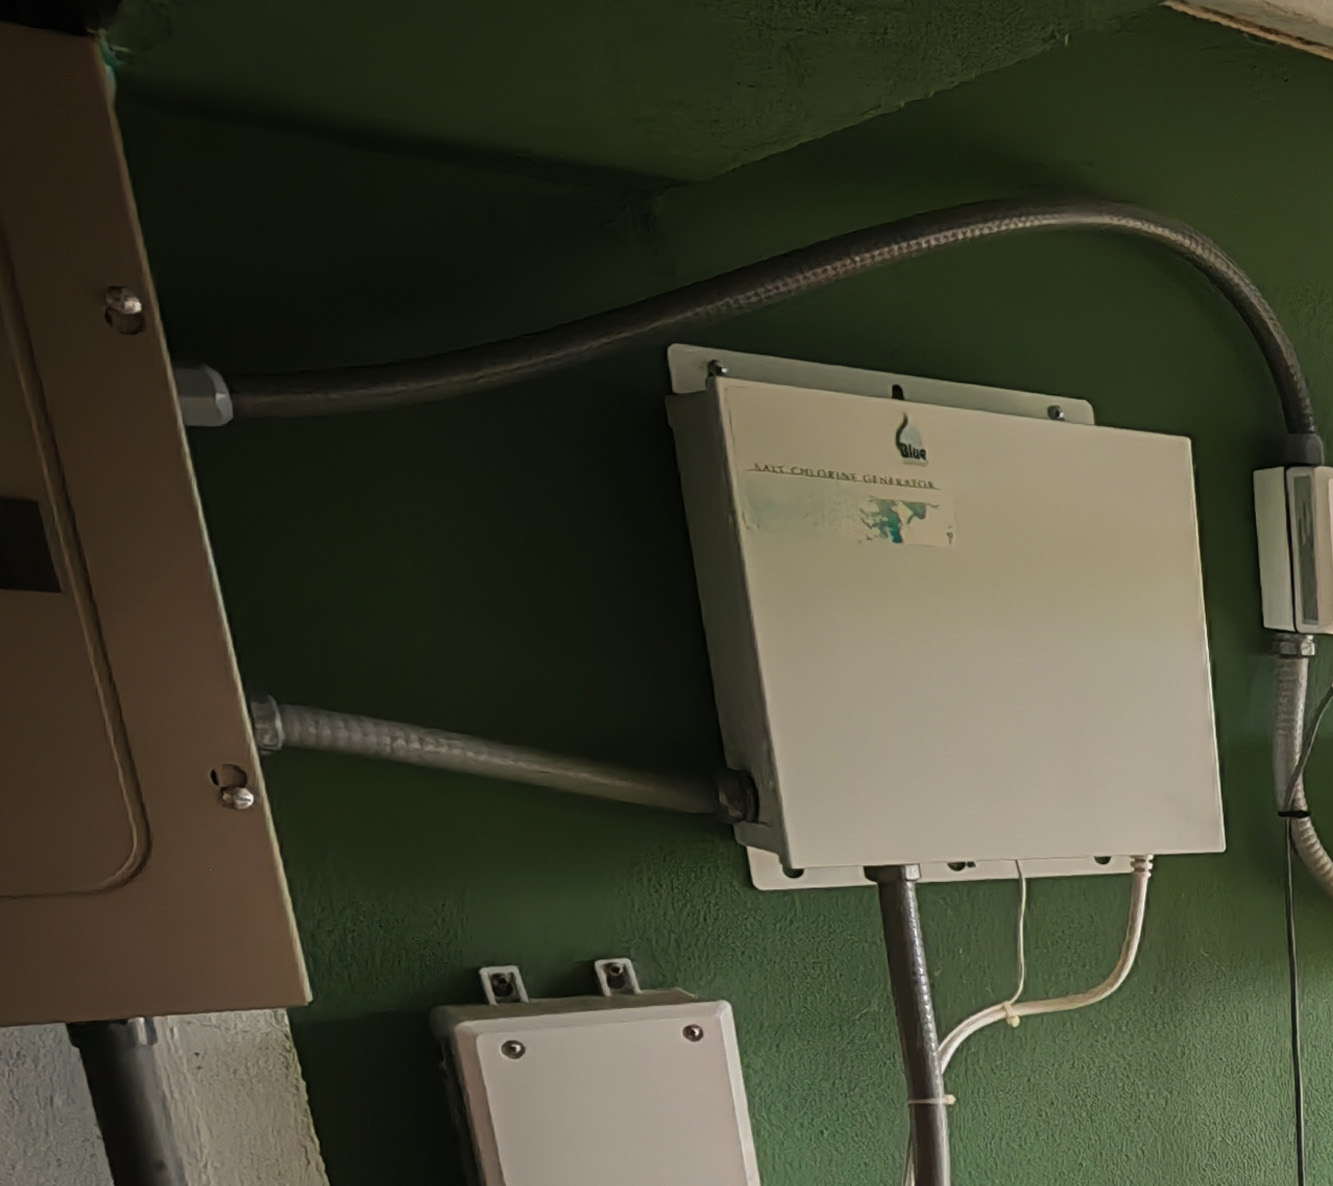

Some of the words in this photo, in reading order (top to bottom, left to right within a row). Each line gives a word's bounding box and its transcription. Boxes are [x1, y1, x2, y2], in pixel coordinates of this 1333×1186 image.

[899, 442, 927, 460] Blue
[754, 463, 785, 474] SALT
[791, 467, 857, 481] CHLORINE
[862, 474, 935, 489] GENERATOR
